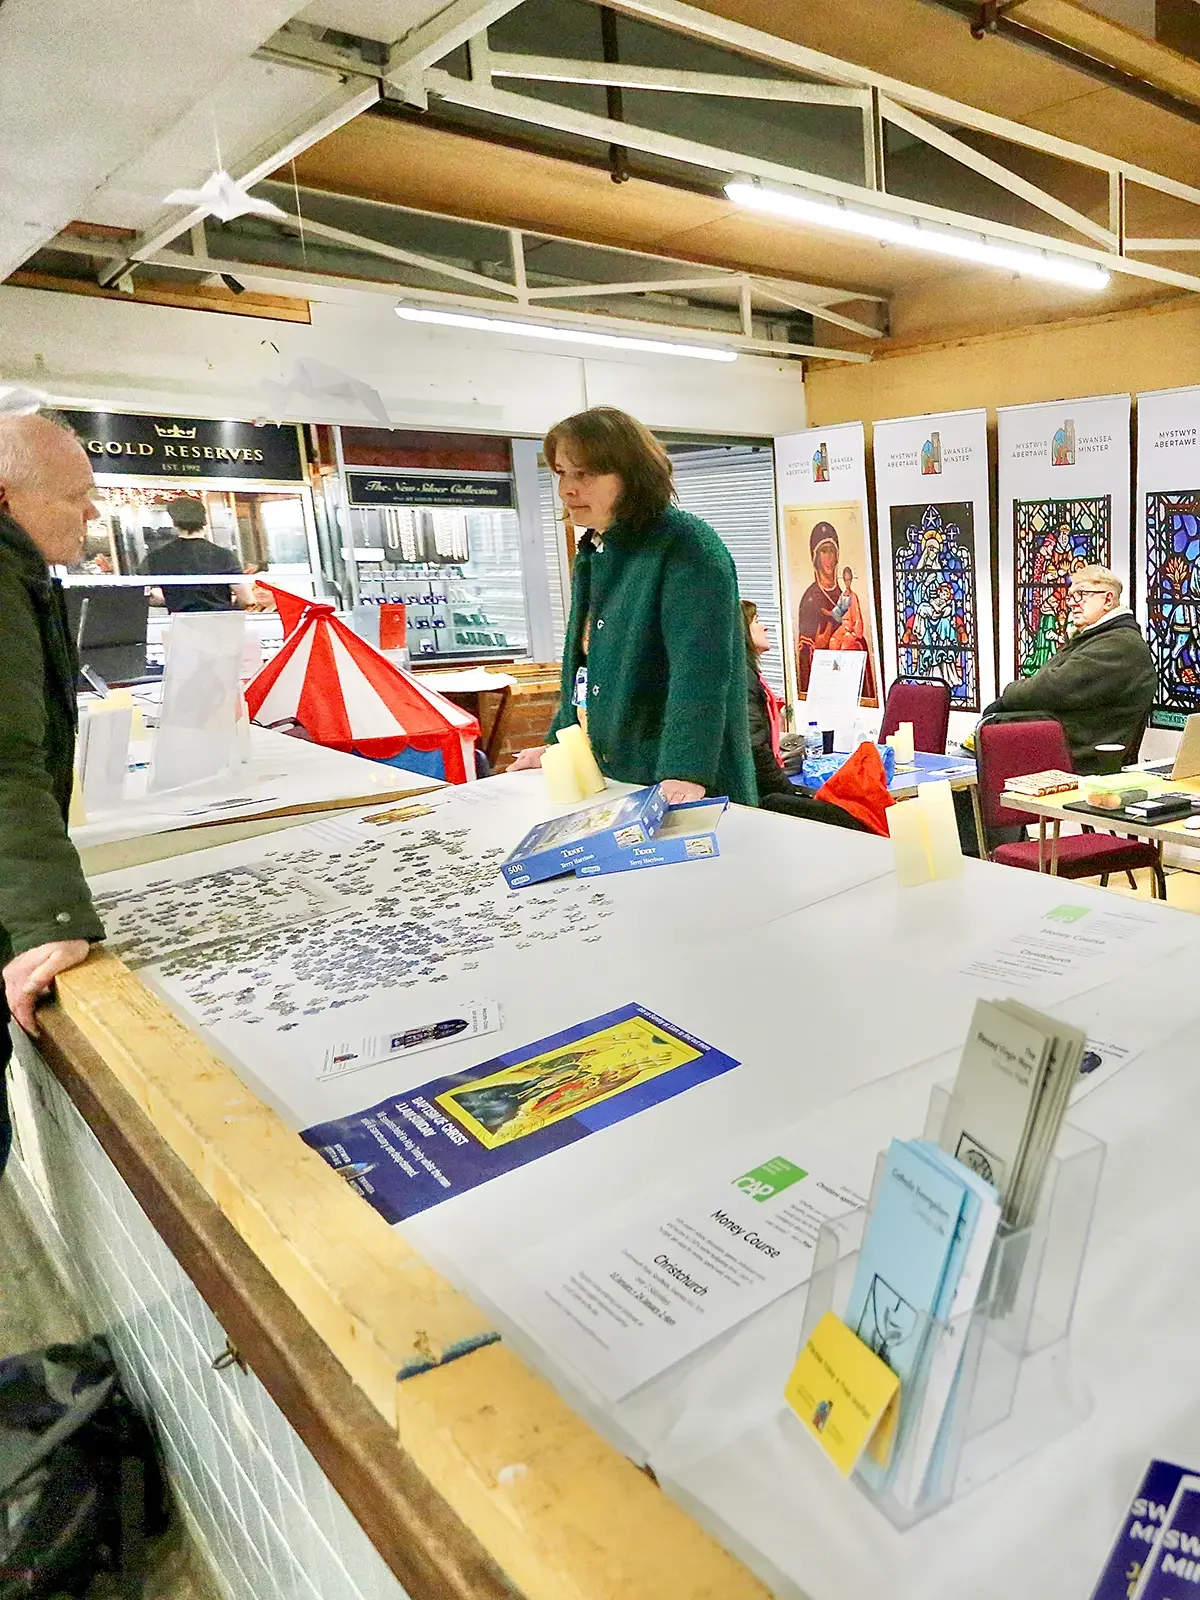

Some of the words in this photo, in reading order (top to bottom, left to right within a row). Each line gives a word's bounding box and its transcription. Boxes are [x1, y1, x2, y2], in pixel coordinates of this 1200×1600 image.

[1158, 429, 1197, 439] MYSTWYR
[1078, 435, 1113, 444] SWANSEA
[1154, 438, 1197, 448] ABERTAWE
[1015, 441, 1048, 450] MYSTWYR
[1078, 444, 1109, 453] MINSTER
[87, 441, 154, 456] GOLD
[164, 445, 264, 462] RESERVES
[890, 452, 918, 460] MYSTWYR
[943, 447, 973, 455] SWANSEA
[1012, 450, 1048, 458] ABERTAWE
[887, 460, 918, 468] ABERTAWE
[943, 455, 971, 463] MINSTER
[162, 463, 179, 471] EST.
[364, 480, 392, 492] The
[417, 483, 449, 494] Silver
[450, 484, 498, 495] Collection
[507, 864, 524, 876] 500
[1040, 928, 1071, 940] Money
[1072, 934, 1106, 945] Course
[408, 1114, 437, 1137] SUNDAY
[411, 1096, 441, 1120] BAPTISM
[441, 1122, 470, 1146] CHRIST
[731, 1176, 775, 1203] CAP
[710, 1209, 746, 1236] Money
[743, 1231, 781, 1259] Course
[653, 1254, 708, 1296] Christchurch
